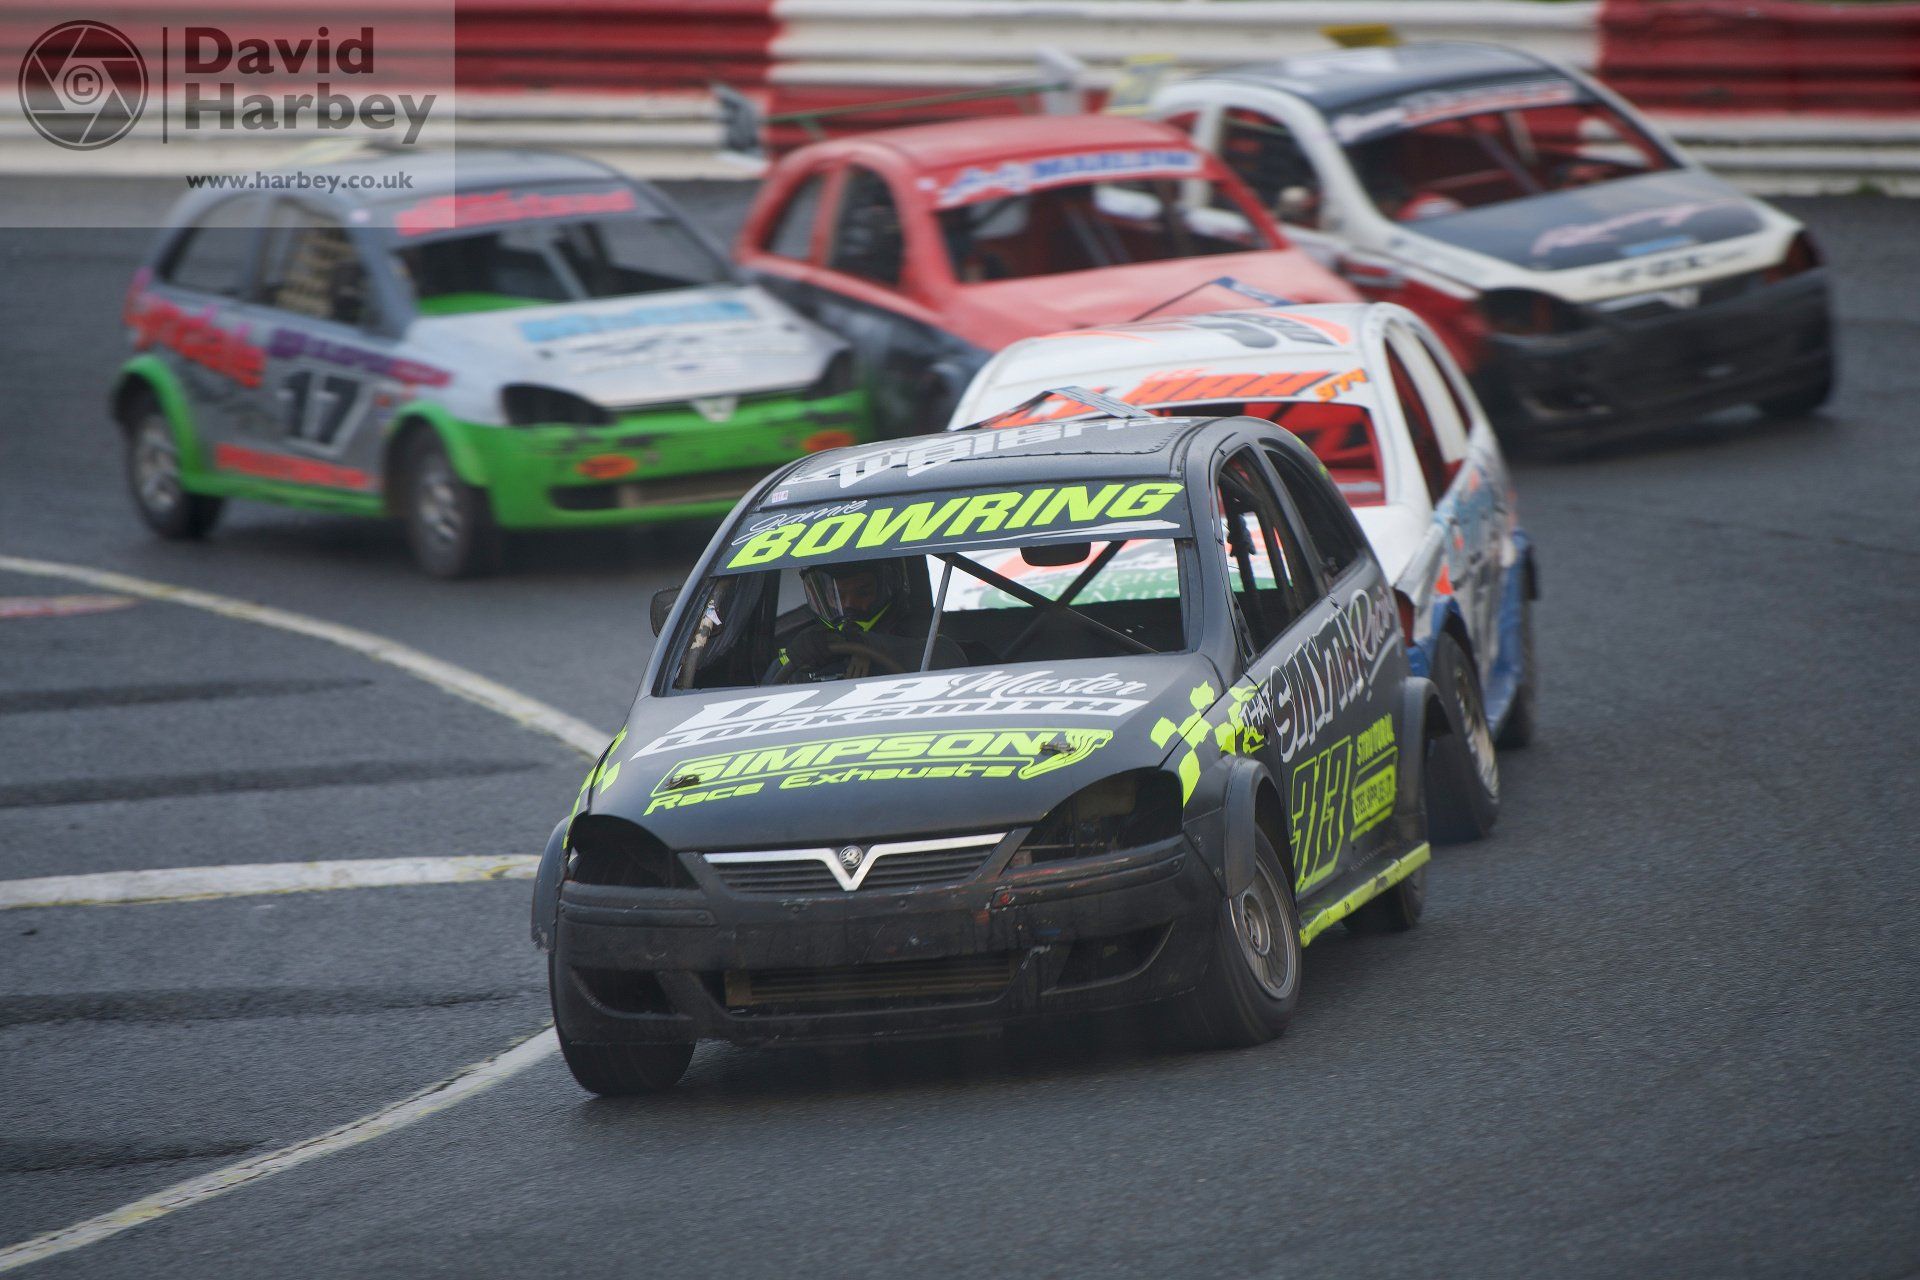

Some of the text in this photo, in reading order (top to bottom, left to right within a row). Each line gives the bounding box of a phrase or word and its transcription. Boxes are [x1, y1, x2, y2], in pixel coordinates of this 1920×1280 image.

[282, 368, 364, 450] 17
[727, 482, 1184, 570] BOWRING
[946, 670, 1148, 699] Master
[642, 699, 1136, 754] LOCKSMITH
[672, 731, 1060, 784] SIMPSON
[642, 763, 1016, 817] Race Exhausts
